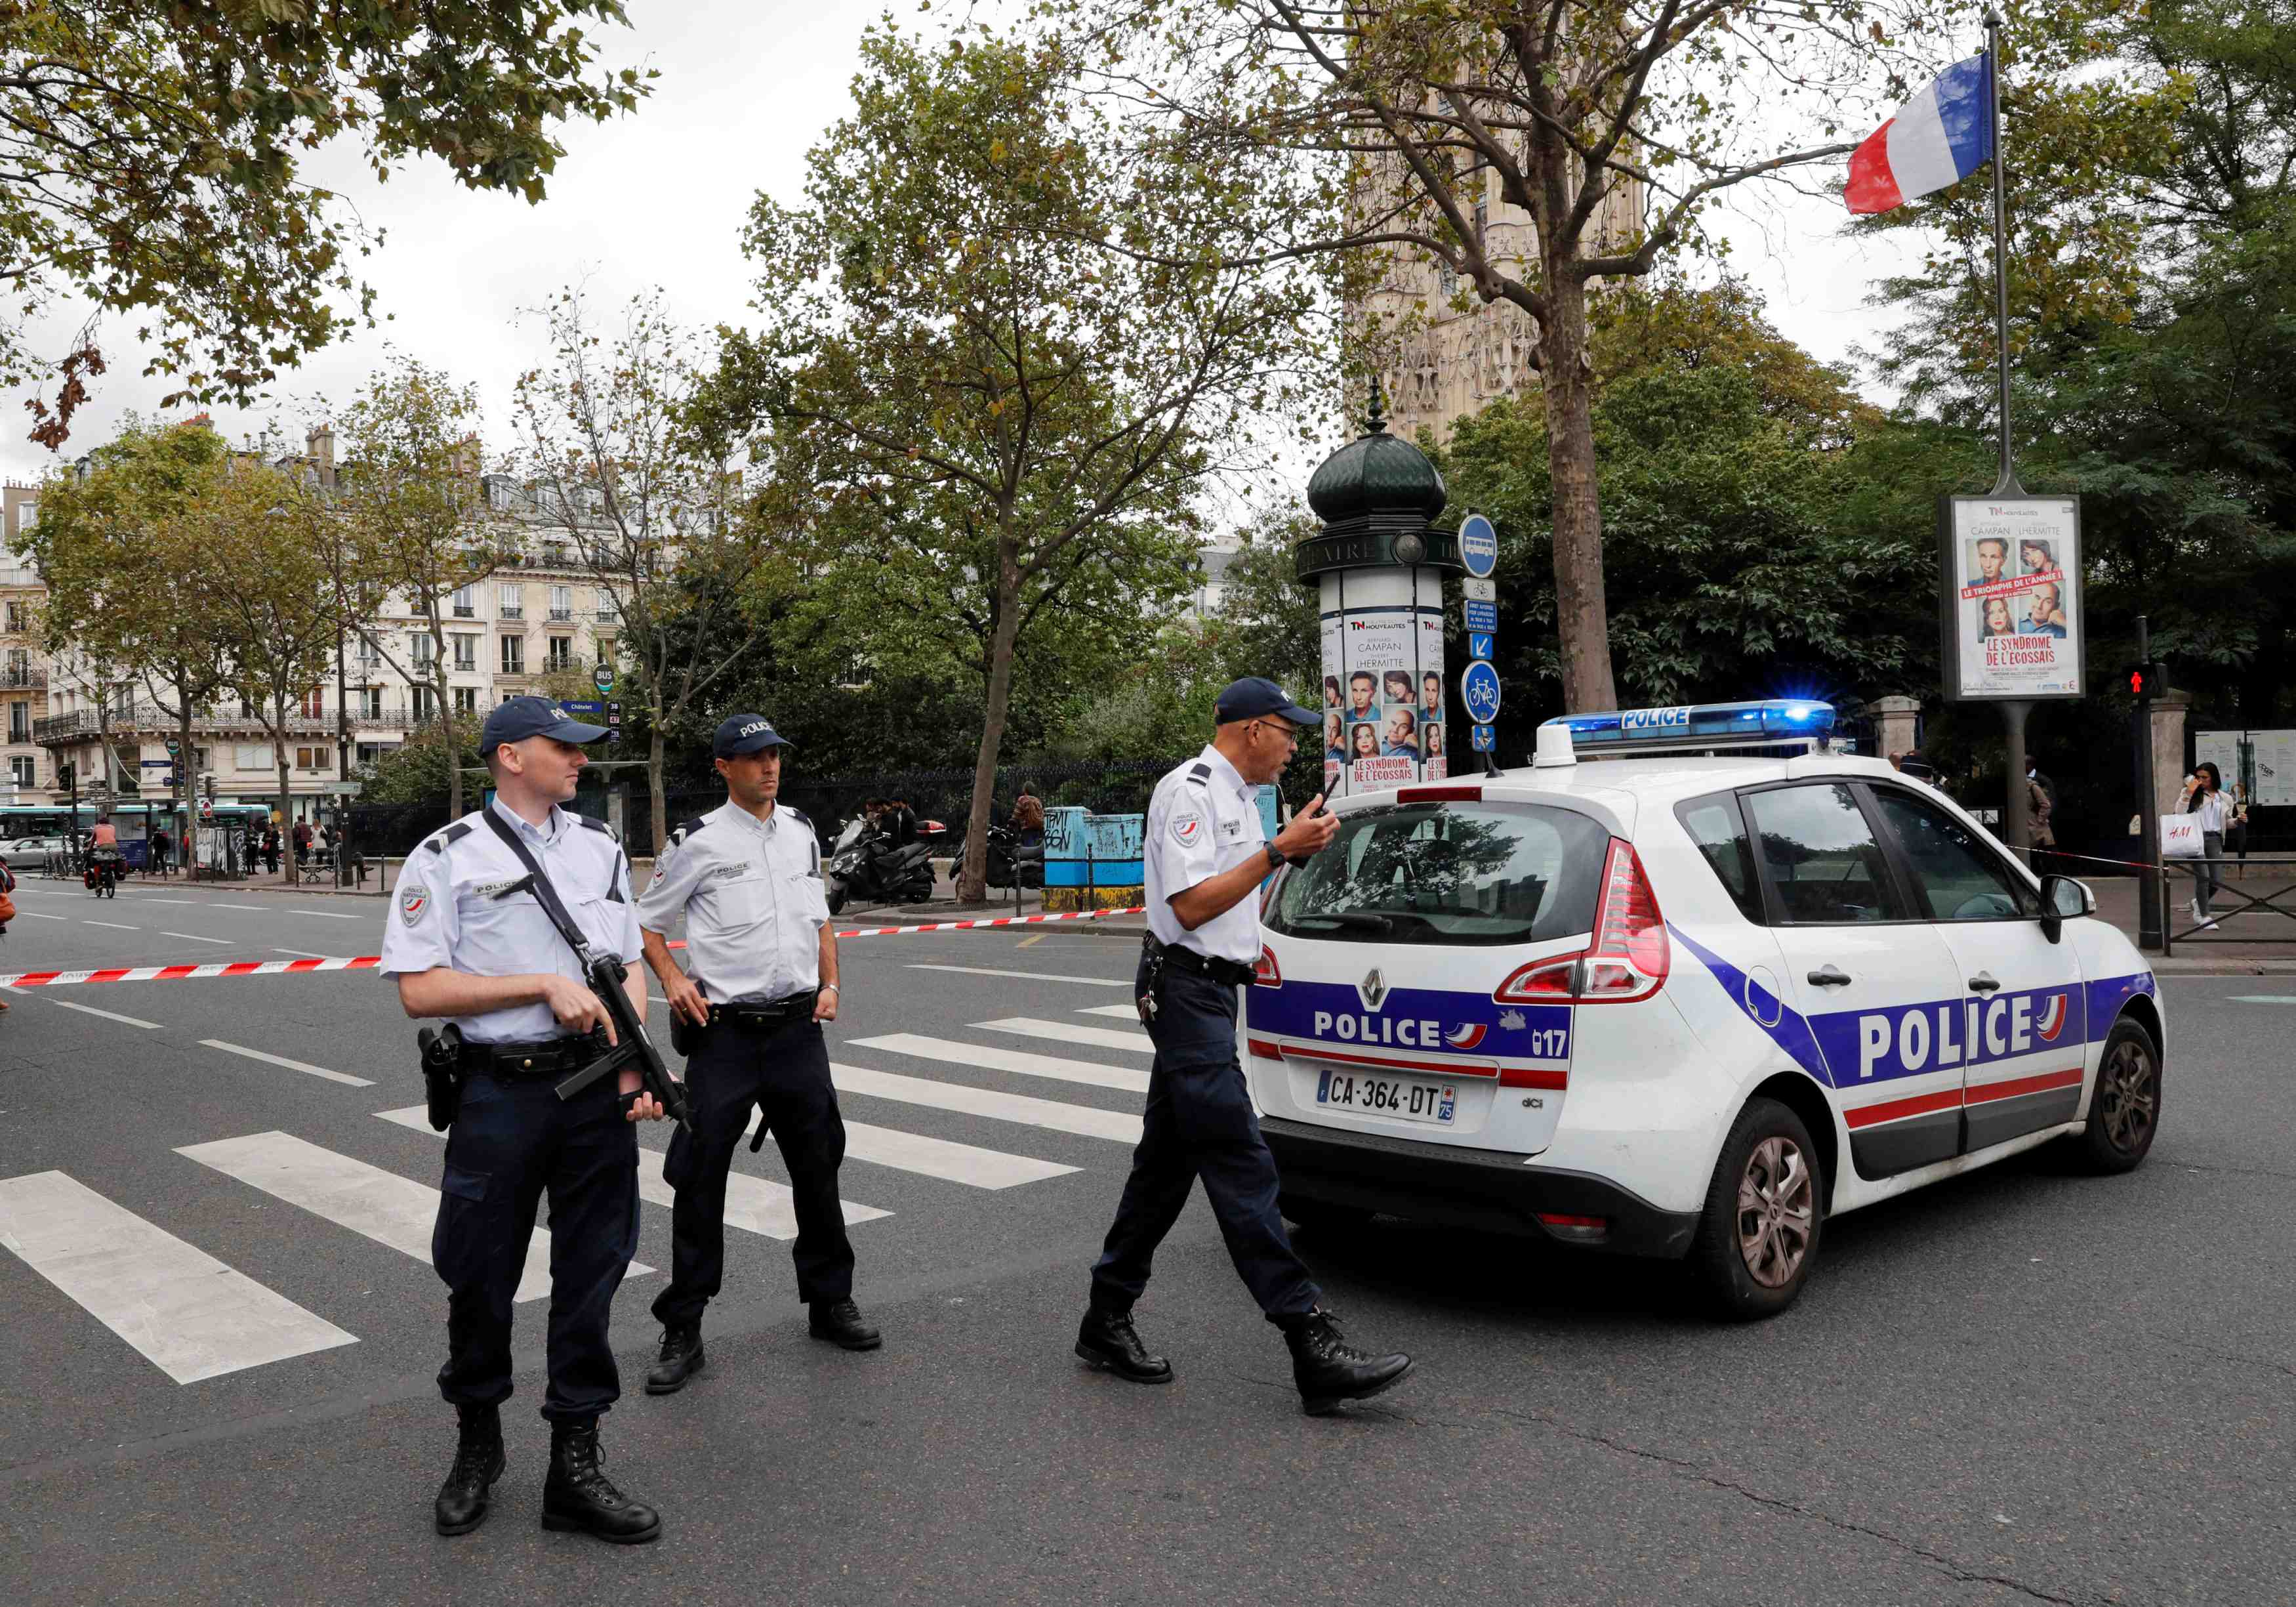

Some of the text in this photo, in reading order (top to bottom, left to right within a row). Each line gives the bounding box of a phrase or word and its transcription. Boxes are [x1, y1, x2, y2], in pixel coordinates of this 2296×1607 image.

[1971, 526, 2060, 535] CAMPAN LHERMITTE
[1973, 581, 2013, 595] TRIOMPHE
[2014, 579, 2024, 588] DE
[1358, 642, 1401, 652] CAMPAN
[1988, 636, 2051, 651] LE SYNDROME
[1357, 658, 1404, 669] LHERMITTE
[1986, 652, 1998, 665] DE
[1624, 709, 1687, 727] POLICE
[1355, 757, 1410, 770] LE SYNDROME
[1355, 770, 1364, 782] DE
[718, 863, 748, 873] POLICE
[1315, 1011, 1440, 1047] POLICE
[1858, 995, 2031, 1078] POLICE
[1331, 1076, 1439, 1116] CA-364-DT
[1522, 1098, 1543, 1108] dCi
[1439, 1104, 1452, 1117] 75
